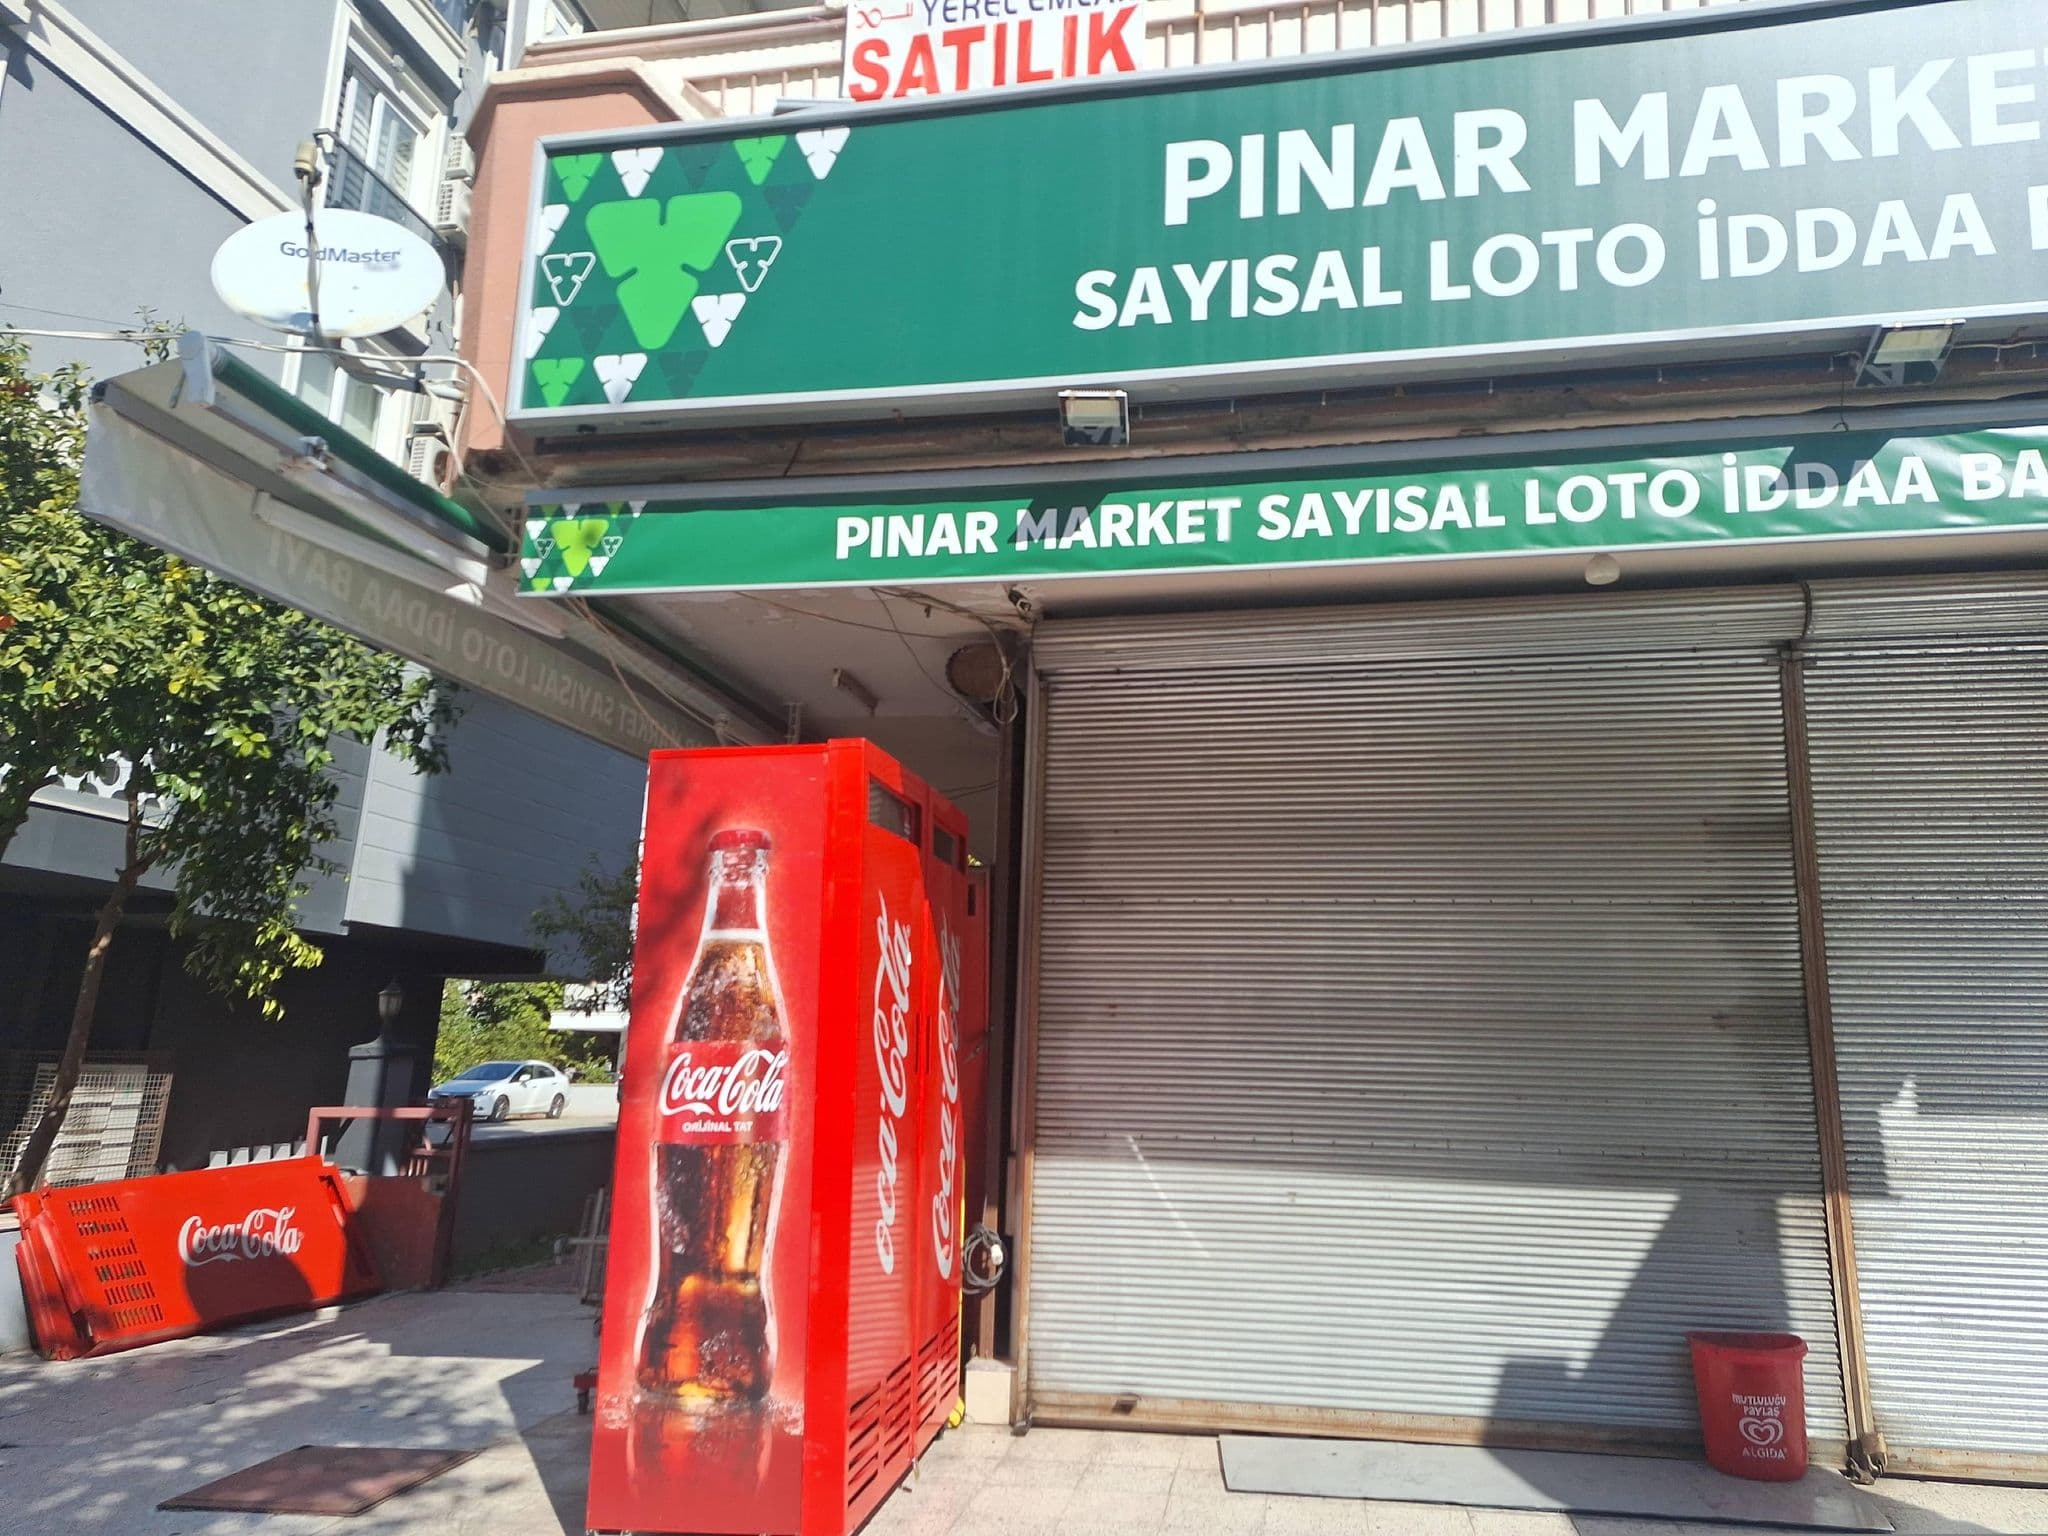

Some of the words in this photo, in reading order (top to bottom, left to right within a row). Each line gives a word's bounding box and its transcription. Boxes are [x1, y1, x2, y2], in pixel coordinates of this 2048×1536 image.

[848, 4, 1139, 102] SATILIK
[1163, 108, 1530, 227] PINAR
[1573, 48, 2048, 188] MARKE
[279, 241, 401, 264] GodMaster
[1072, 248, 1404, 331] SAYISAL
[1429, 222, 1667, 302] LOTO
[1697, 193, 1998, 280] İDDAA
[835, 508, 999, 561] PINAR
[1014, 497, 1242, 552] MARKET
[1256, 480, 1506, 541] SAYISAL
[1524, 469, 1701, 526] LOTO
[1721, 450, 1940, 514] İDDAA
[659, 1048, 790, 1116] Coca-Cola
[178, 1205, 304, 1267] Coca-Cola
[1742, 1446, 1785, 1460] ALGIDA
